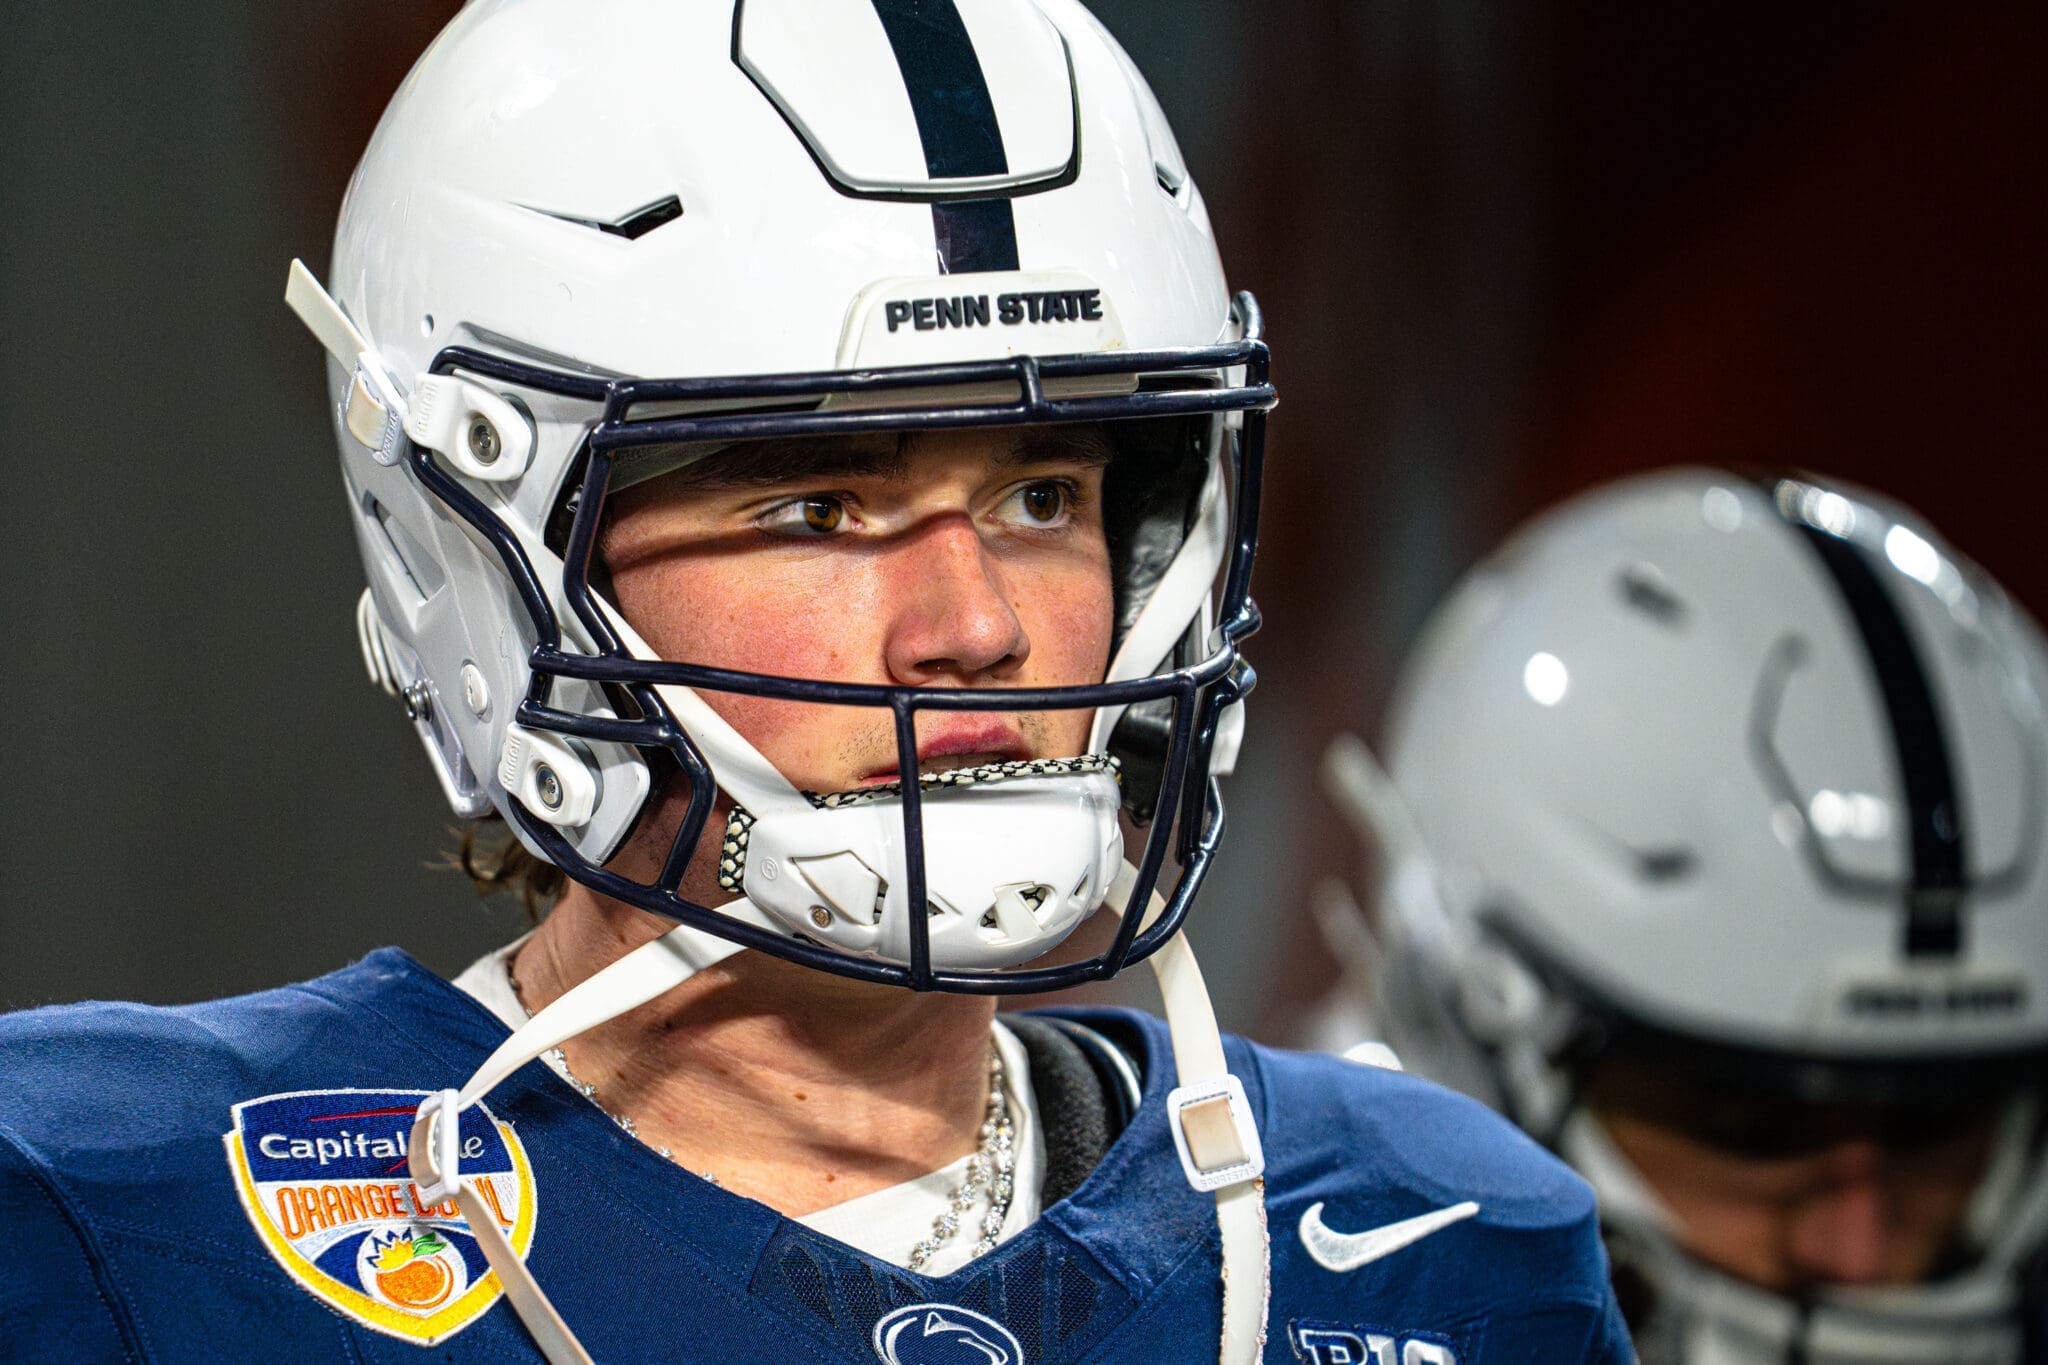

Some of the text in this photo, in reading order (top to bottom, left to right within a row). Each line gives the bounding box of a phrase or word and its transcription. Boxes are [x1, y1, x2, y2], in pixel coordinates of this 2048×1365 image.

[885, 288, 1104, 333] PENN STATE
[503, 735, 521, 788] Riddell
[258, 1130, 408, 1165] Capital
[276, 1183, 408, 1240] ORANGE
